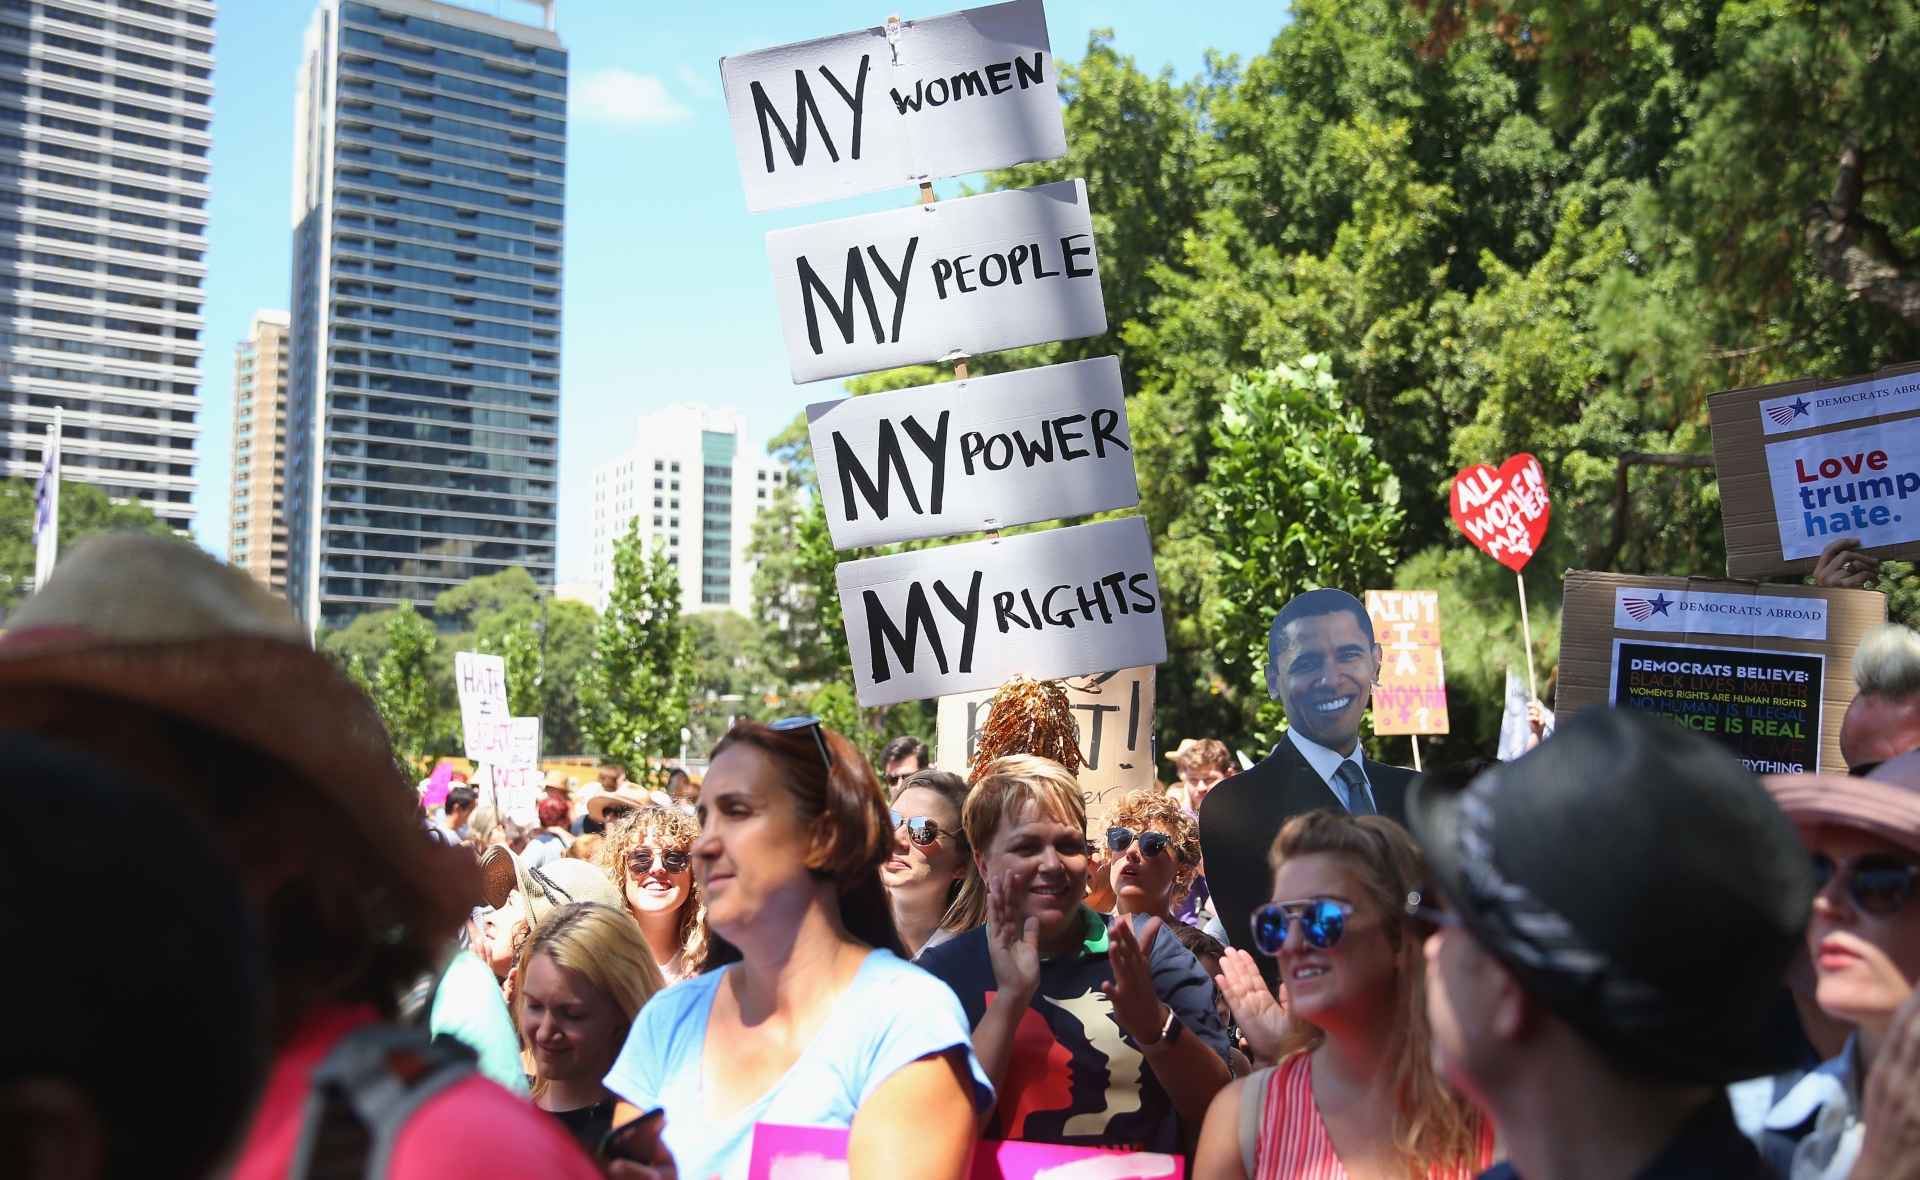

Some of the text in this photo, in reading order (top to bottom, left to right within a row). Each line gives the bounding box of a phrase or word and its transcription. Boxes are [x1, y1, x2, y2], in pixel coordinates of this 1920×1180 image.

[750, 52, 1044, 173] MY WOMEN
[796, 233, 1094, 355] MY PEOPLE
[1816, 389, 1889, 408] DEMOCRATS
[832, 408, 1130, 521] MY POWER
[1795, 450, 1888, 484] Love
[1457, 467, 1503, 513] ALL
[1465, 460, 1542, 541] WOMEN
[1799, 472, 1920, 510] trump
[1804, 504, 1901, 537] hate.
[1679, 601, 1821, 621] DEMOCRATS ABROAD
[862, 570, 1157, 684] MY RIGHTS
[1391, 622, 1419, 650] I
[1395, 650, 1417, 676] A
[1631, 659, 1809, 682] DEMOCRATS BELIEVE:
[463, 657, 503, 702] HATE
[1630, 672, 1808, 697] BLACK LIVES MATTER
[1629, 687, 1807, 708] WOMEN'S RIGHTS ARE HUMAN RIGHTS
[1629, 697, 1806, 722] NO HUMAN IS ILLEGAL
[1725, 717, 1743, 734] IS
[1751, 720, 1806, 739] REAL
[1738, 735, 1805, 762] LOVE
[1735, 758, 1804, 775] RYTHING
